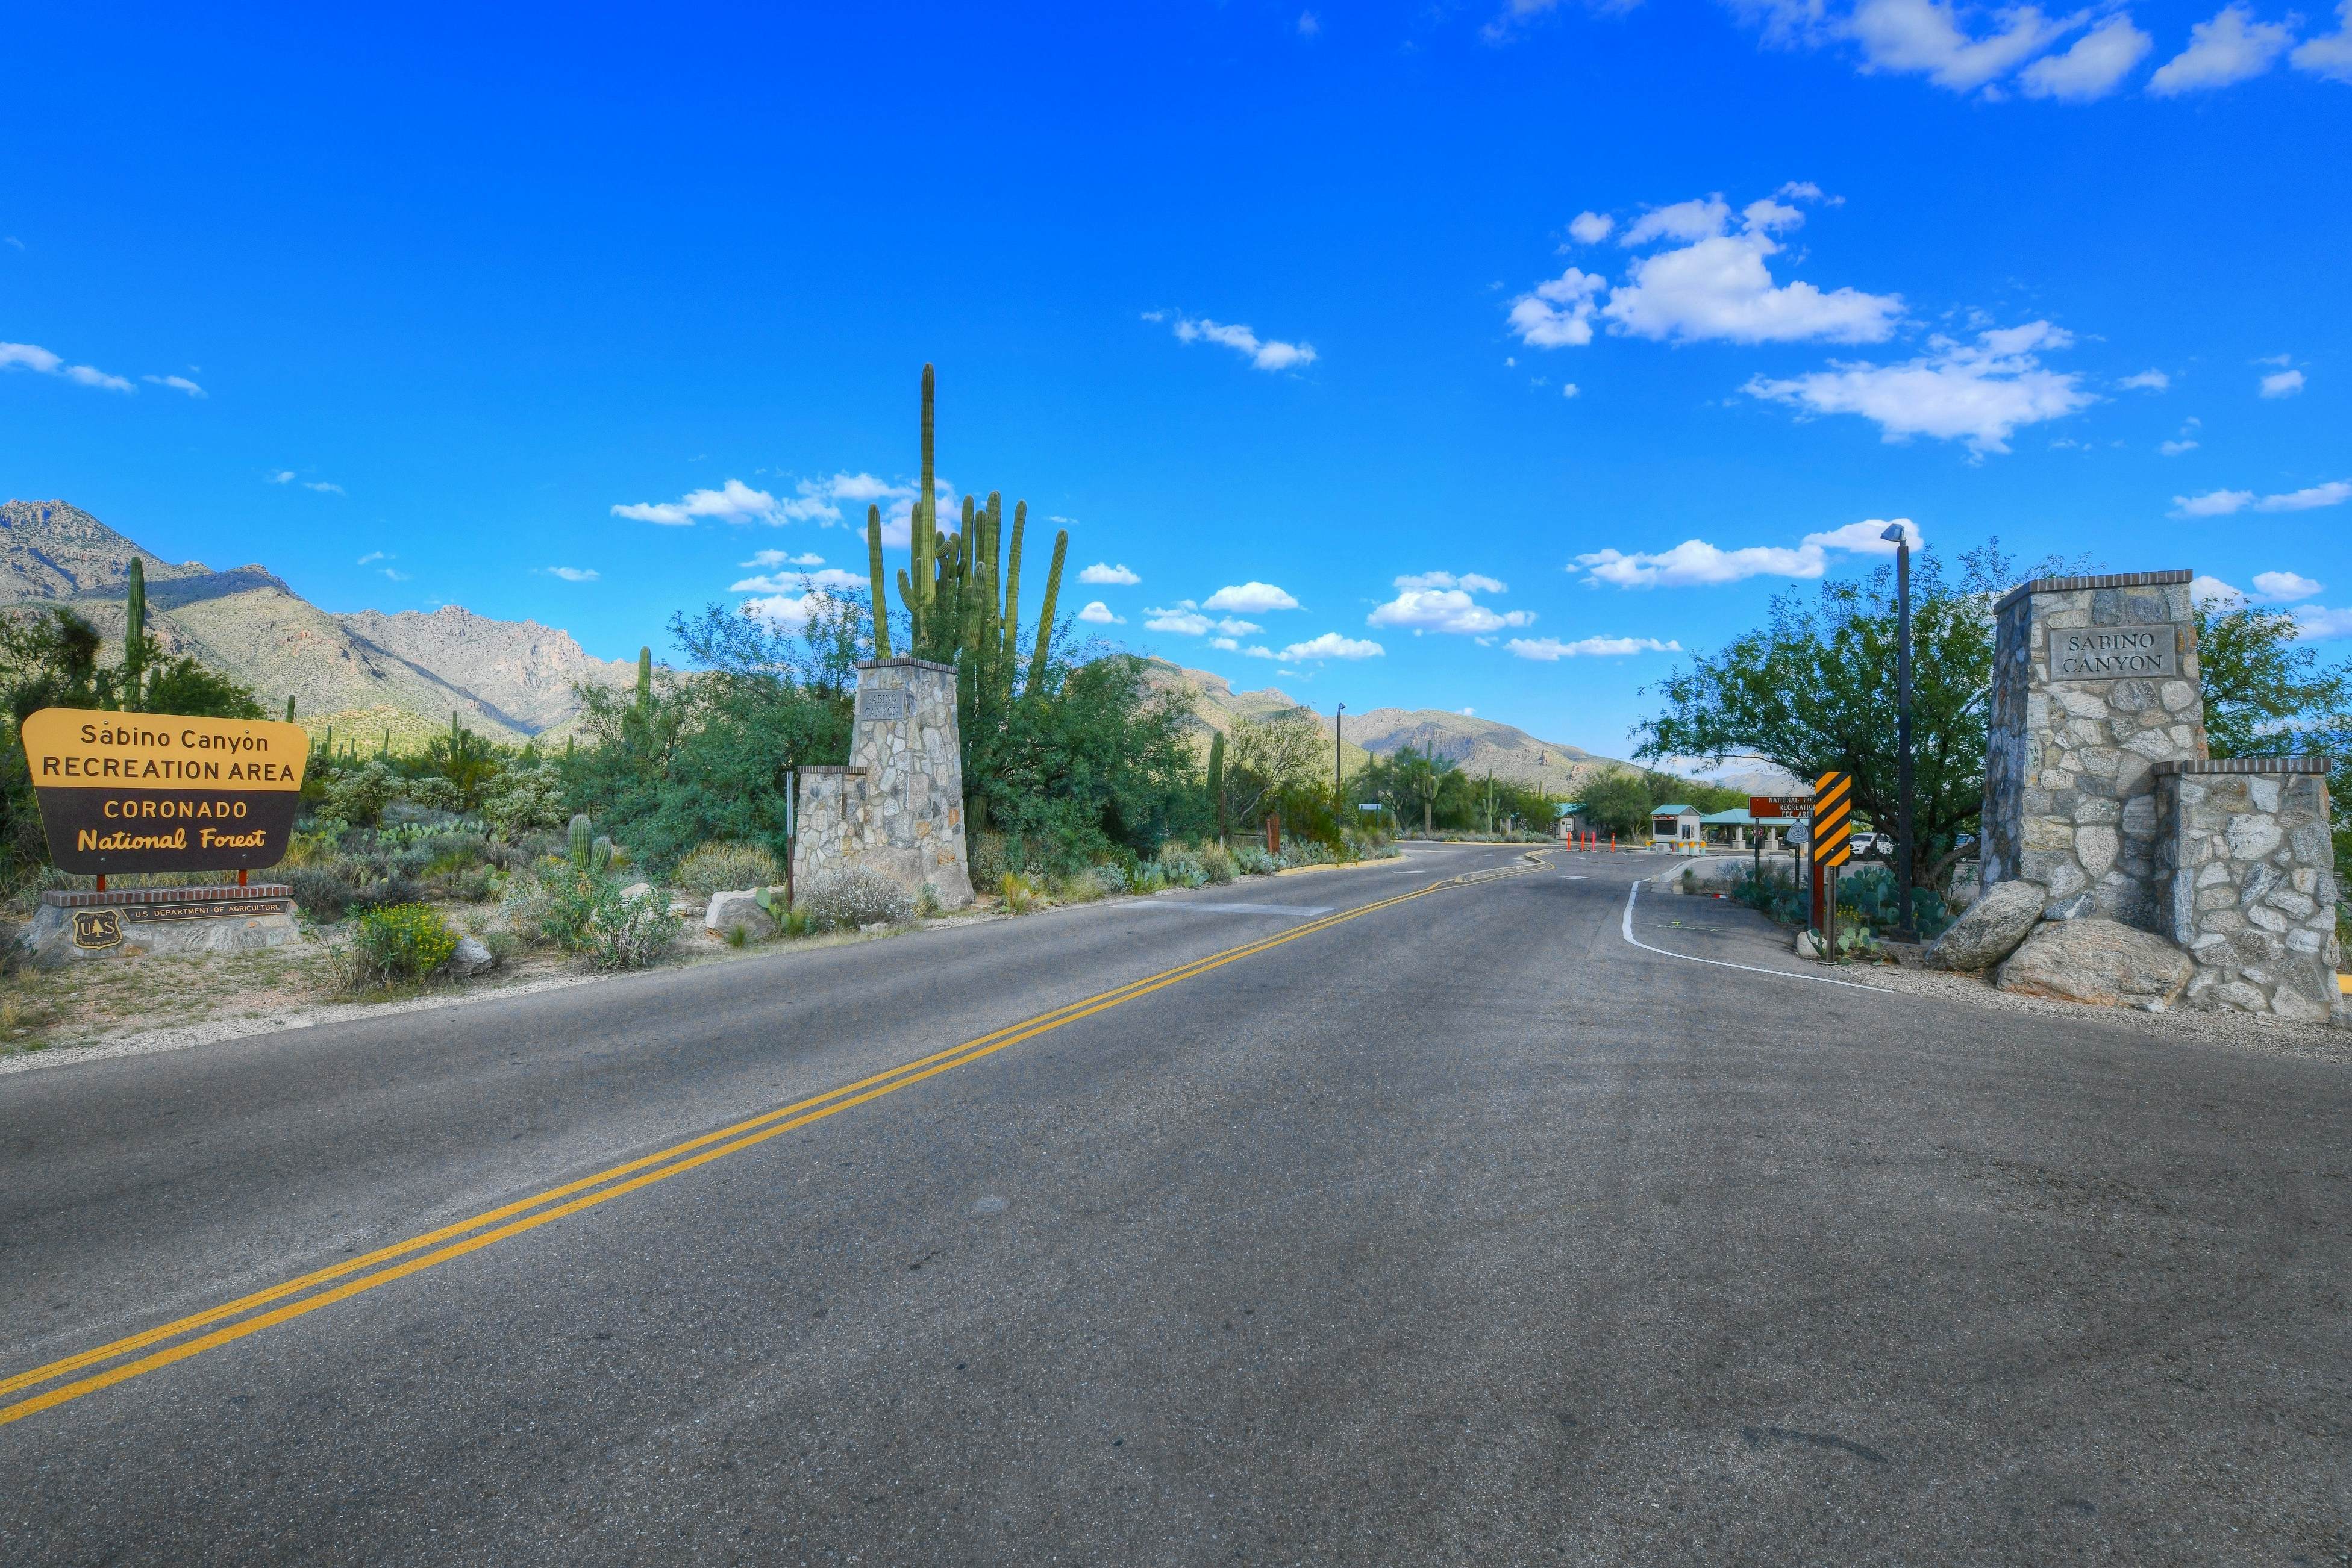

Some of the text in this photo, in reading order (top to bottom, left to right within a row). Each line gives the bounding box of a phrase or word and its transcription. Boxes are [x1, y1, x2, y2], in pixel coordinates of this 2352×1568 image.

[2068, 633, 2155, 652] SABINO
[2063, 654, 2162, 673] CANYON
[868, 694, 897, 704] SABINO
[865, 706, 899, 717] CANYON
[80, 724, 269, 754] Sabino Canyon
[43, 757, 295, 781] RECREATION AREA
[104, 800, 248, 819] CORONADO
[77, 828, 266, 852] National Forest
[154, 908, 210, 917] DEPARTMENT
